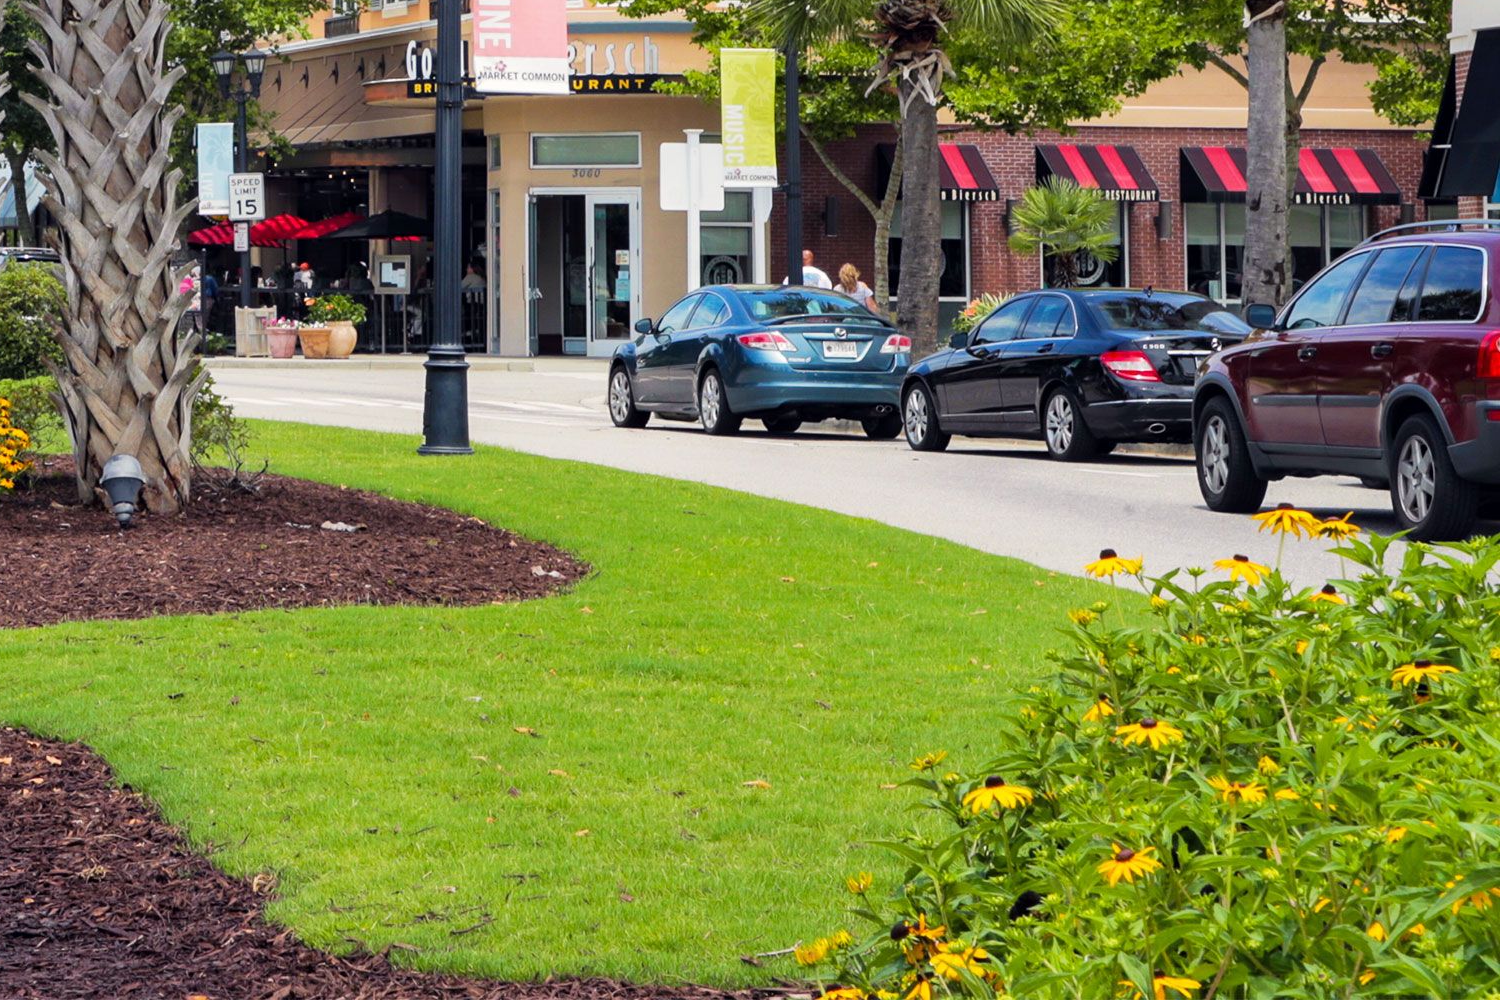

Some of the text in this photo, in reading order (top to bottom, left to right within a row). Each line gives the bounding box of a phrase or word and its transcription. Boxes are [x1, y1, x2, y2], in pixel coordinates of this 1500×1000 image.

[479, 72, 565, 82] MARKET COMMON
[724, 104, 746, 165] MUSIC
[231, 178, 260, 187] SPEED
[1105, 190, 1156, 201] RESTAURANT
[237, 199, 257, 216] 15
